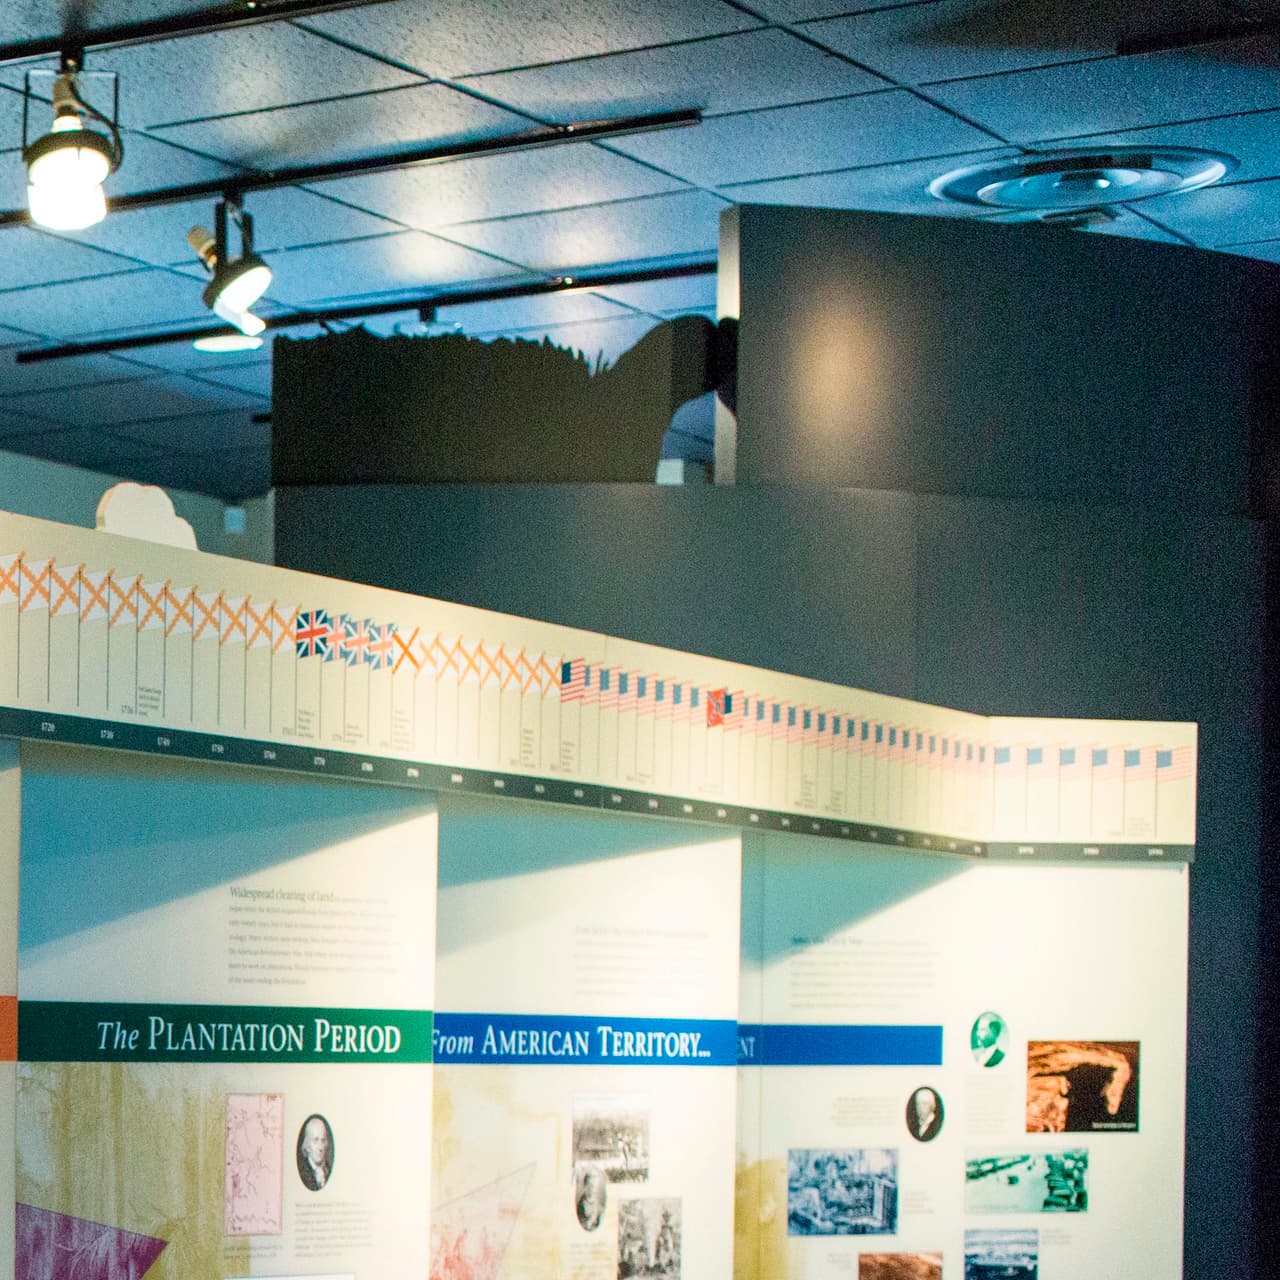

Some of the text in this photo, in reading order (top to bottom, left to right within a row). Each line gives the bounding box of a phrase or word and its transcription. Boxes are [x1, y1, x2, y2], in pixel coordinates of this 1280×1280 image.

[97, 1016, 402, 1053] The PLANTATION PERIOD
[482, 1024, 589, 1056] AMERICAN
[597, 1026, 711, 1057] TERRITORY...
